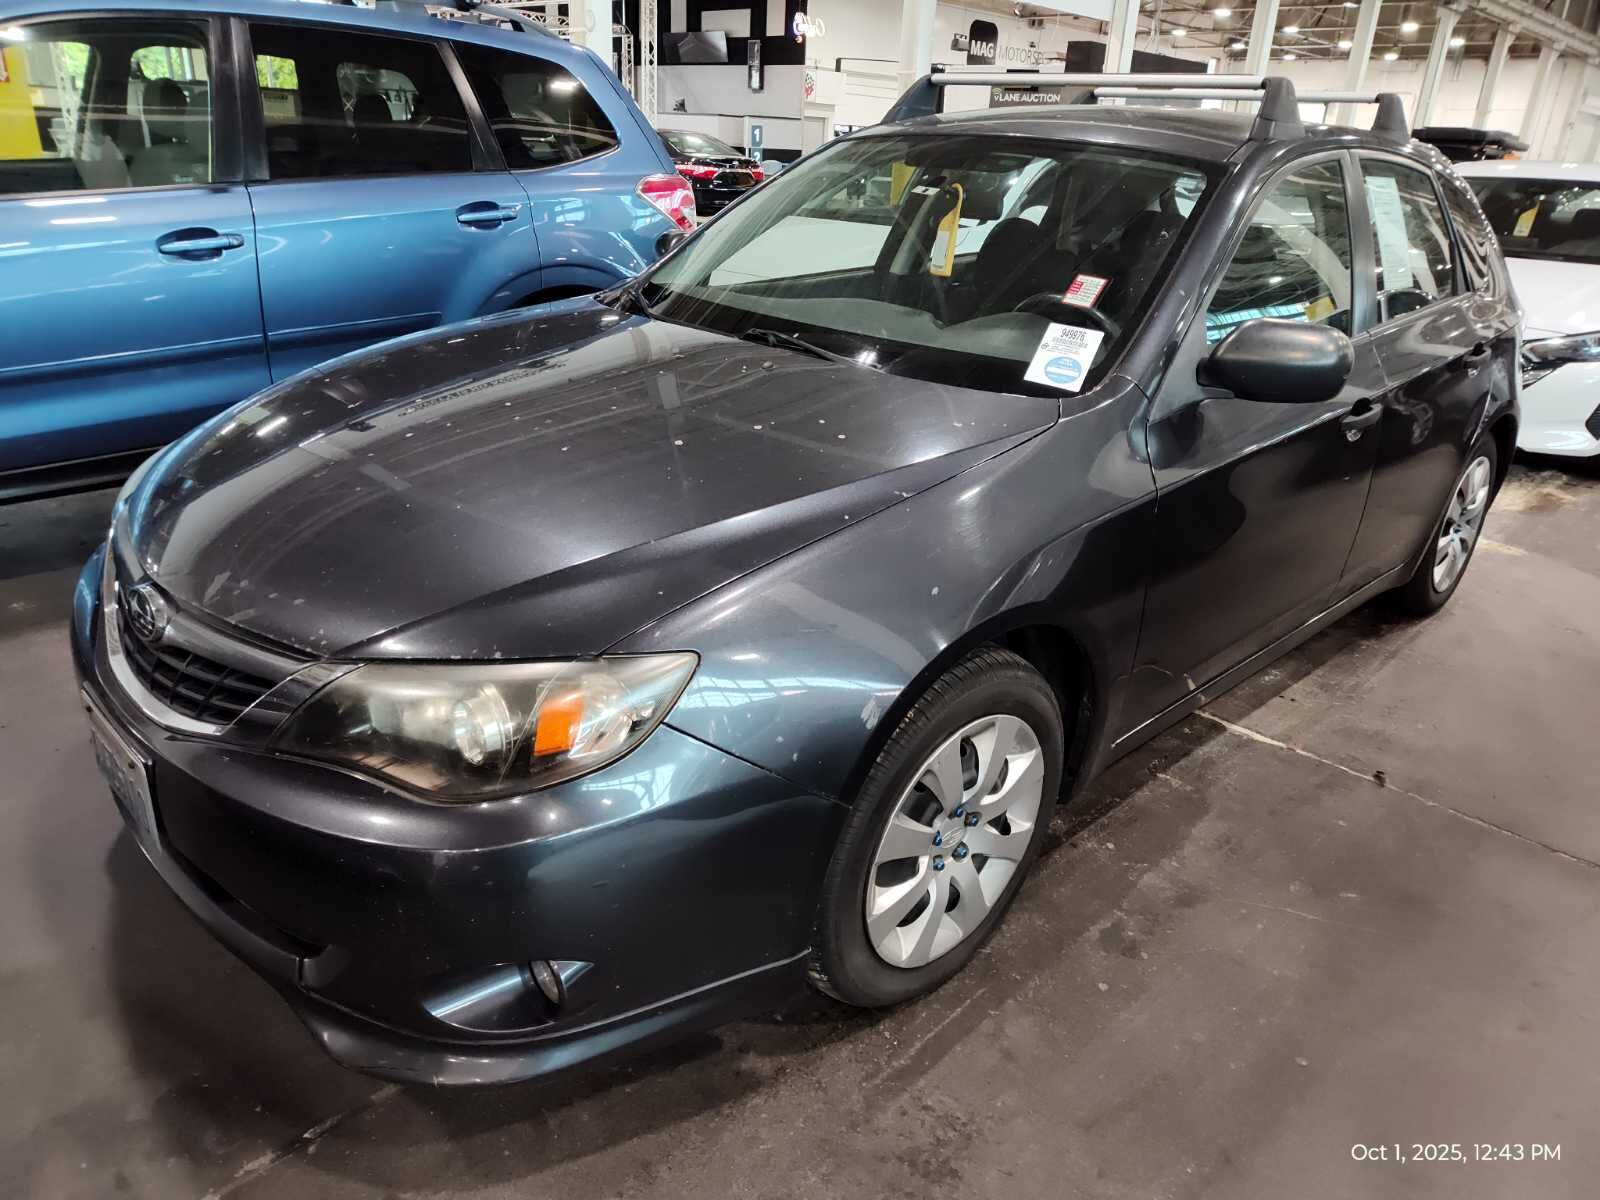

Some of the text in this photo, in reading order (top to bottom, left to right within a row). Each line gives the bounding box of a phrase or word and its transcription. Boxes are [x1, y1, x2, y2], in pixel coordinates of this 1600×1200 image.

[970, 39, 994, 57] MAG
[1022, 94, 1060, 102] AUCTION
[754, 128, 760, 142] 1
